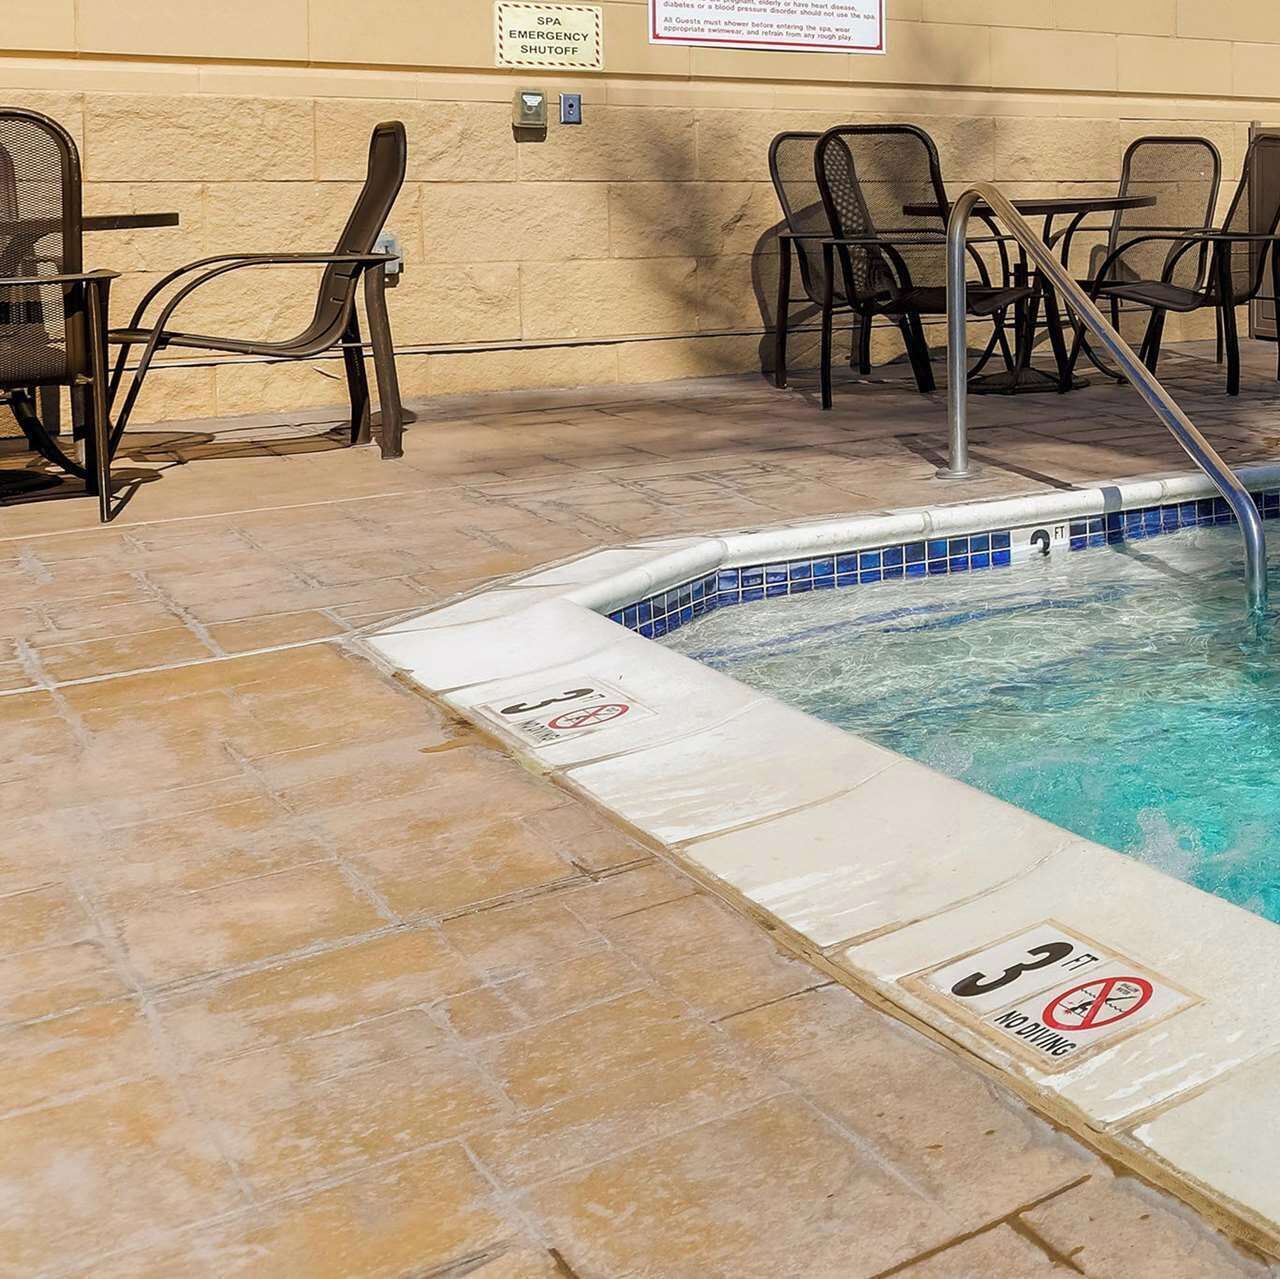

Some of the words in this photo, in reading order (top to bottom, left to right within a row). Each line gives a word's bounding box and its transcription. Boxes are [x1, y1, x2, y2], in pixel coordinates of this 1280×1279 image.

[537, 16, 562, 26] SPA
[509, 29, 590, 42] EMERGENCY
[520, 44, 579, 56] SHUTOFF
[1054, 526, 1065, 540] FT
[500, 688, 594, 715] 3
[951, 941, 1074, 997] 3
[1061, 953, 1099, 971] FT
[994, 1010, 1029, 1029] NO
[1015, 1022, 1077, 1056] DIVING
